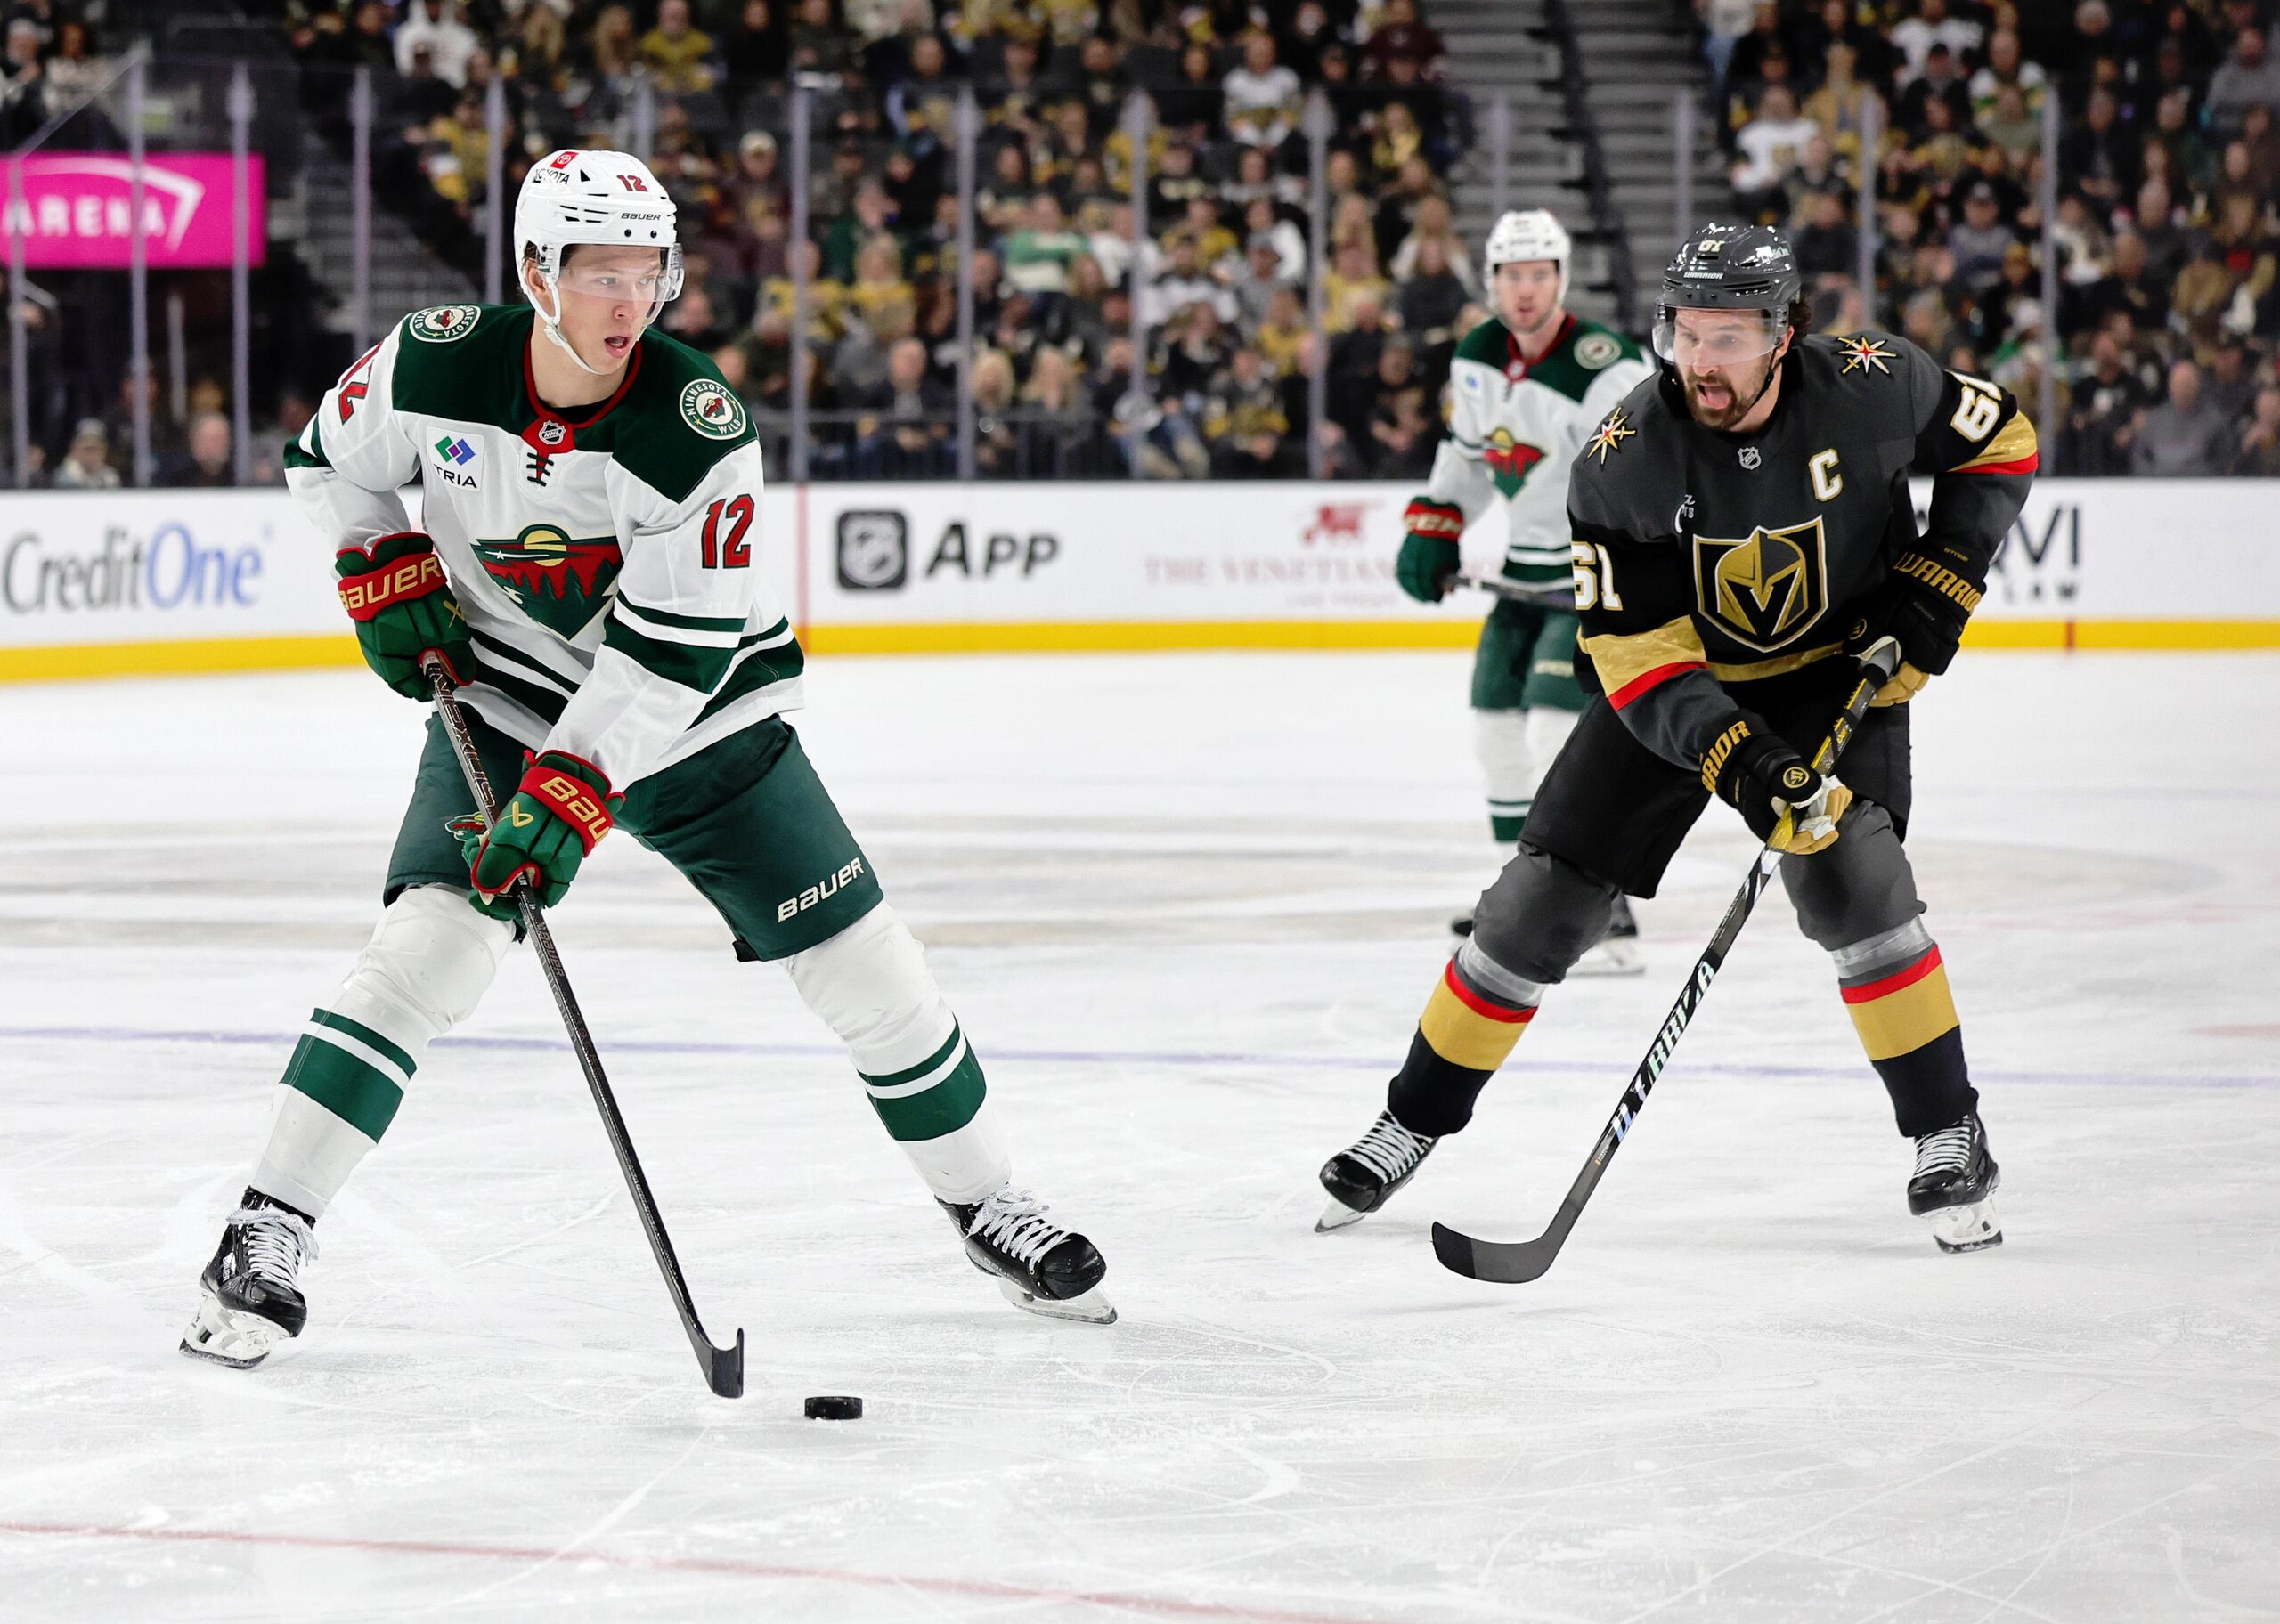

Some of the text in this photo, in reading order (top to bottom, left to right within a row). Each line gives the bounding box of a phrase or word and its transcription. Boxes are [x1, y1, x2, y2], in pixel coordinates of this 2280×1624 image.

[616, 175, 648, 192] 12
[1, 193, 167, 238] ARENA
[621, 212, 661, 221] BAUER
[1683, 272, 1724, 280] WARRIOR
[685, 383, 727, 416] MINNESOTA
[1944, 369, 2003, 443] 61
[717, 418, 742, 434] WILD
[433, 463, 477, 489] TRIA
[1808, 448, 1843, 501] C
[701, 493, 754, 569] 12
[338, 556, 442, 611] BAUER
[1571, 540, 1624, 612] 61
[778, 857, 864, 922] BAUER
